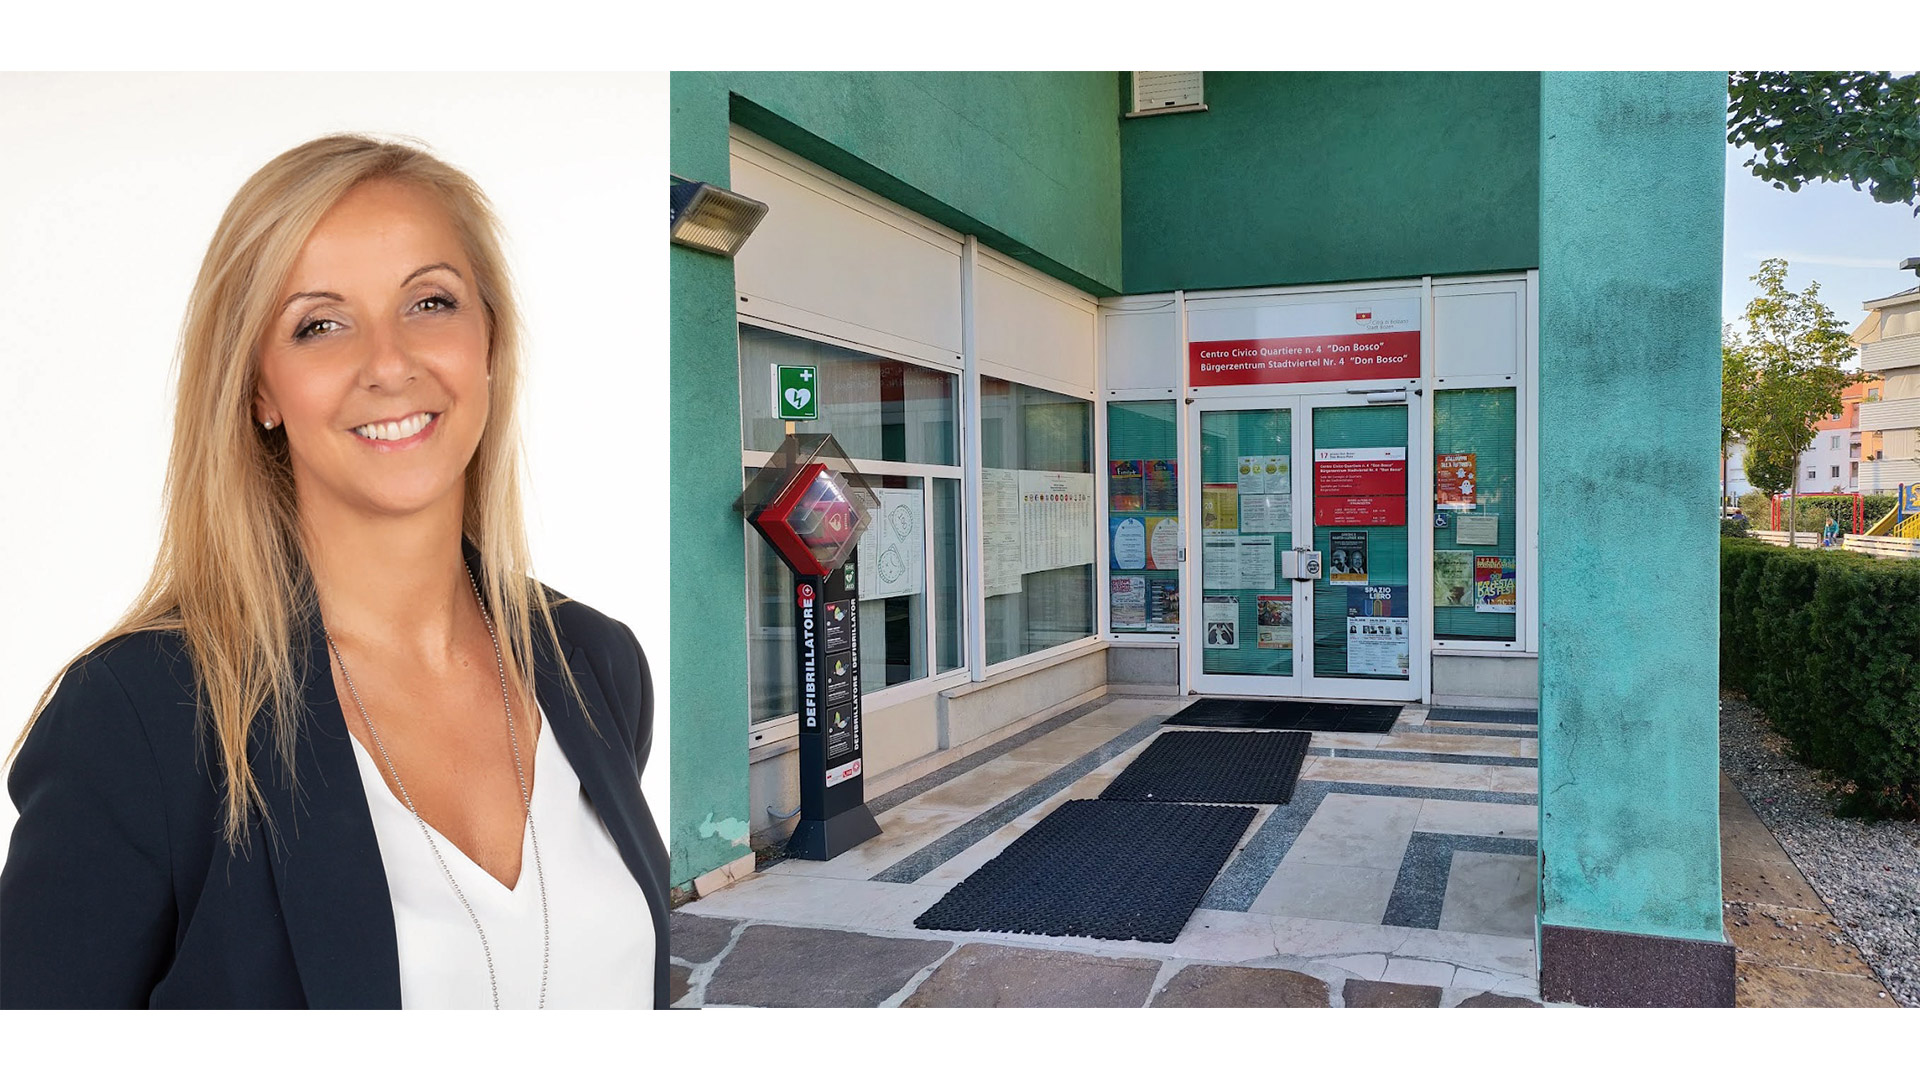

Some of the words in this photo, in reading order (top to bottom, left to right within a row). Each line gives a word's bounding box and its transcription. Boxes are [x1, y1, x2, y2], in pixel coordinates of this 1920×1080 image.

[1200, 350, 1229, 359] Centro
[1231, 348, 1258, 357] Civico
[1260, 346, 1303, 356] Quartiere
[1316, 345, 1322, 353] 4
[1200, 361, 1266, 373] Bürgerzentrum
[1268, 358, 1320, 369] Stadtviertel
[1323, 358, 1337, 366] Nr.
[1339, 358, 1345, 366] 4
[803, 598, 817, 727] DEFIBRILLATORE
